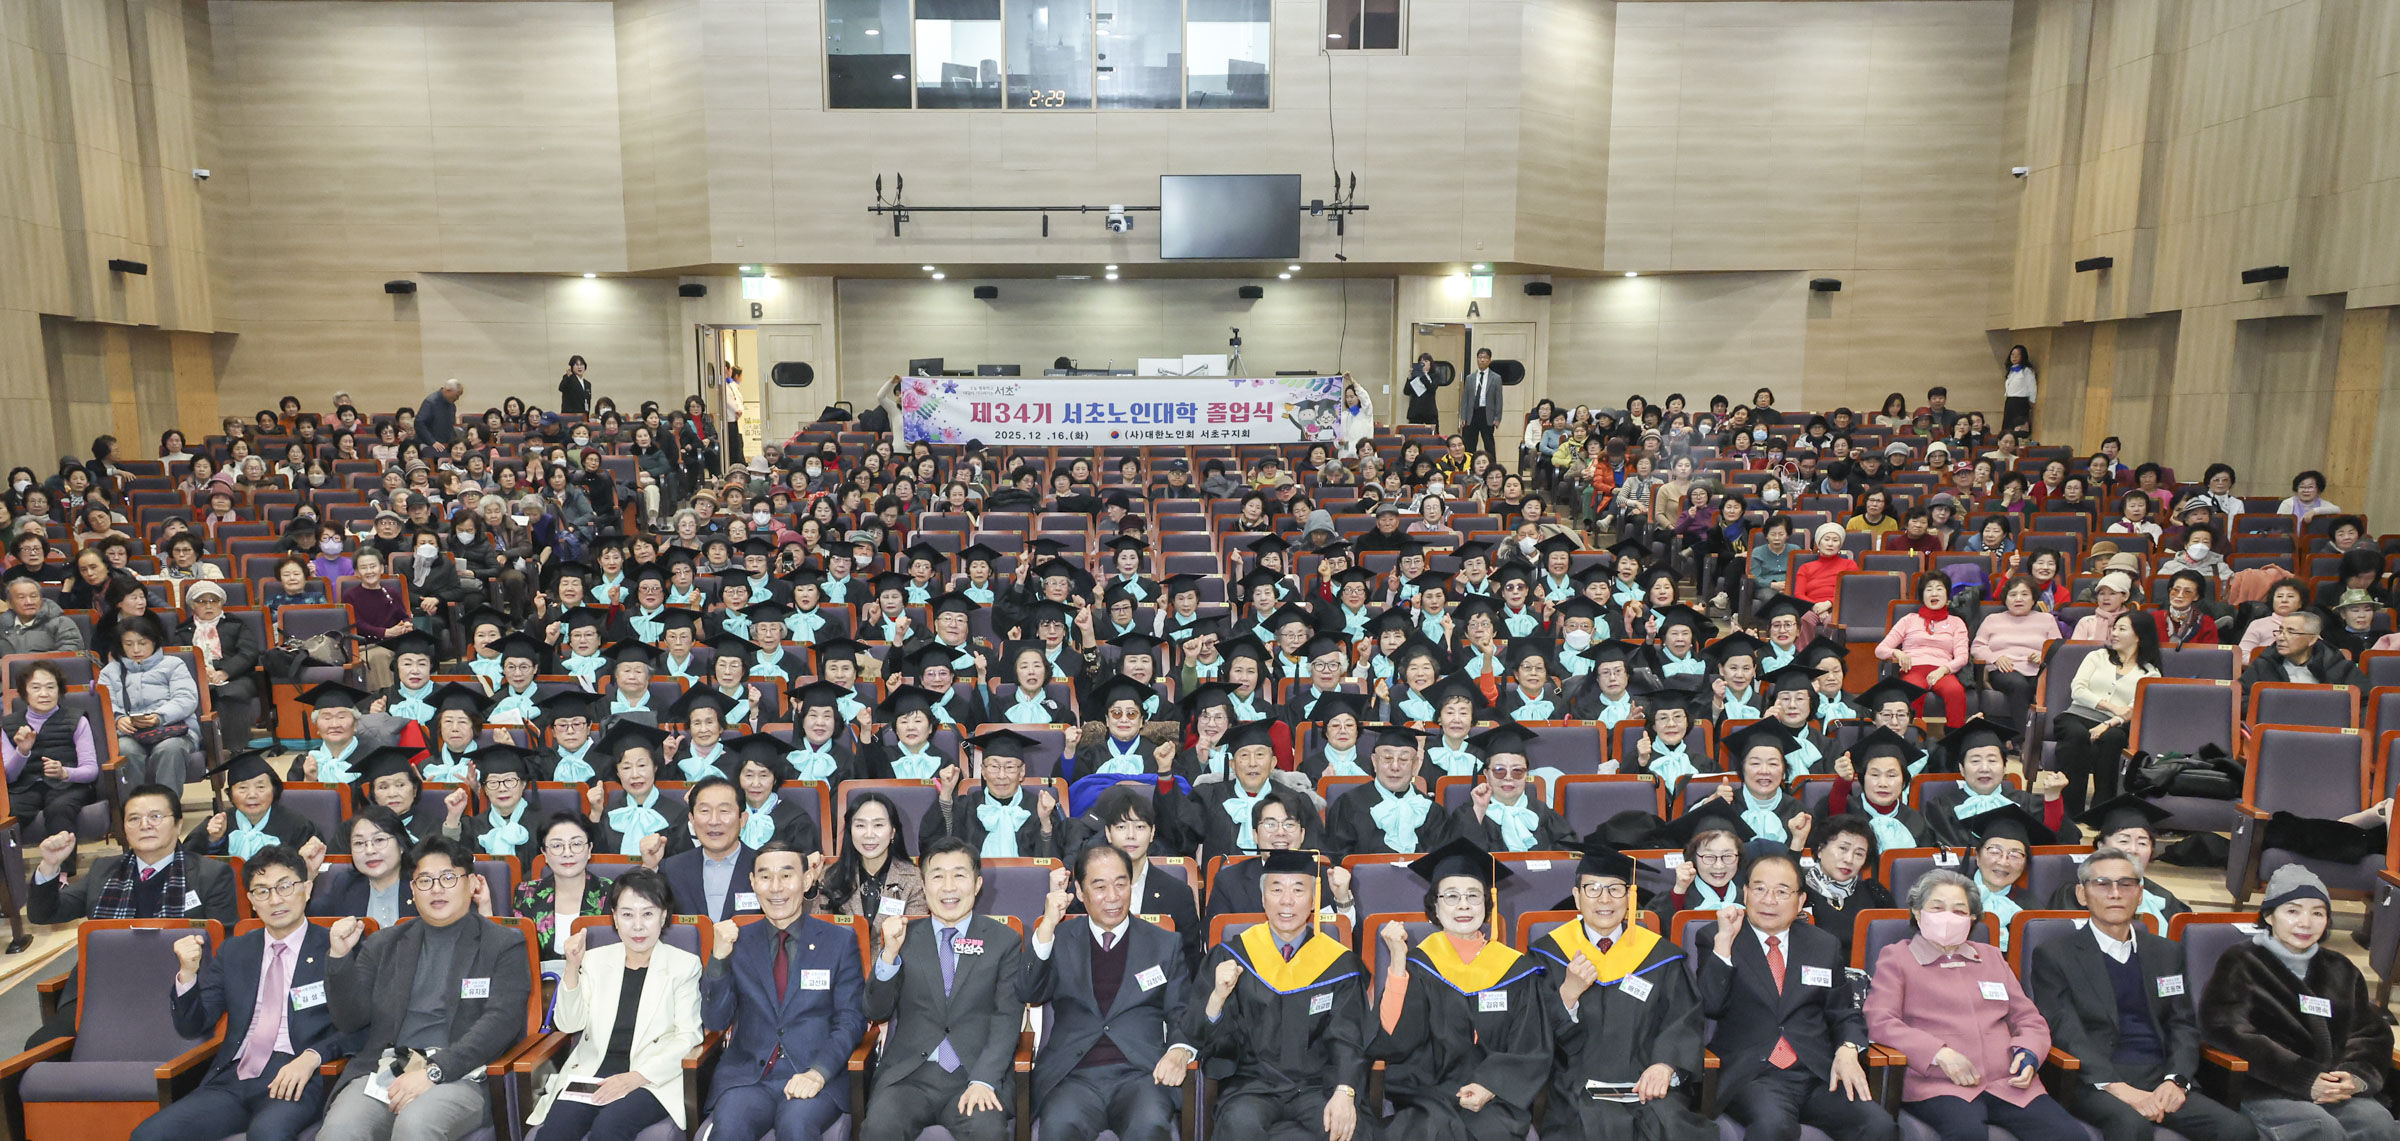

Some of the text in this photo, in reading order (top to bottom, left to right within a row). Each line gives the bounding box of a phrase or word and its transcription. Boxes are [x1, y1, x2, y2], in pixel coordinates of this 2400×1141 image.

[1029, 89, 1066, 107] 2:29
[751, 302, 763, 318] B
[1466, 301, 1480, 317] A
[994, 386, 1015, 396] 서초
[970, 402, 1273, 424] 제34기 서초노인대학 졸업식
[1124, 429, 1195, 440] (사)대한노인회
[1200, 429, 1251, 438] 서초구지회
[954, 943, 985, 955] 전성수
